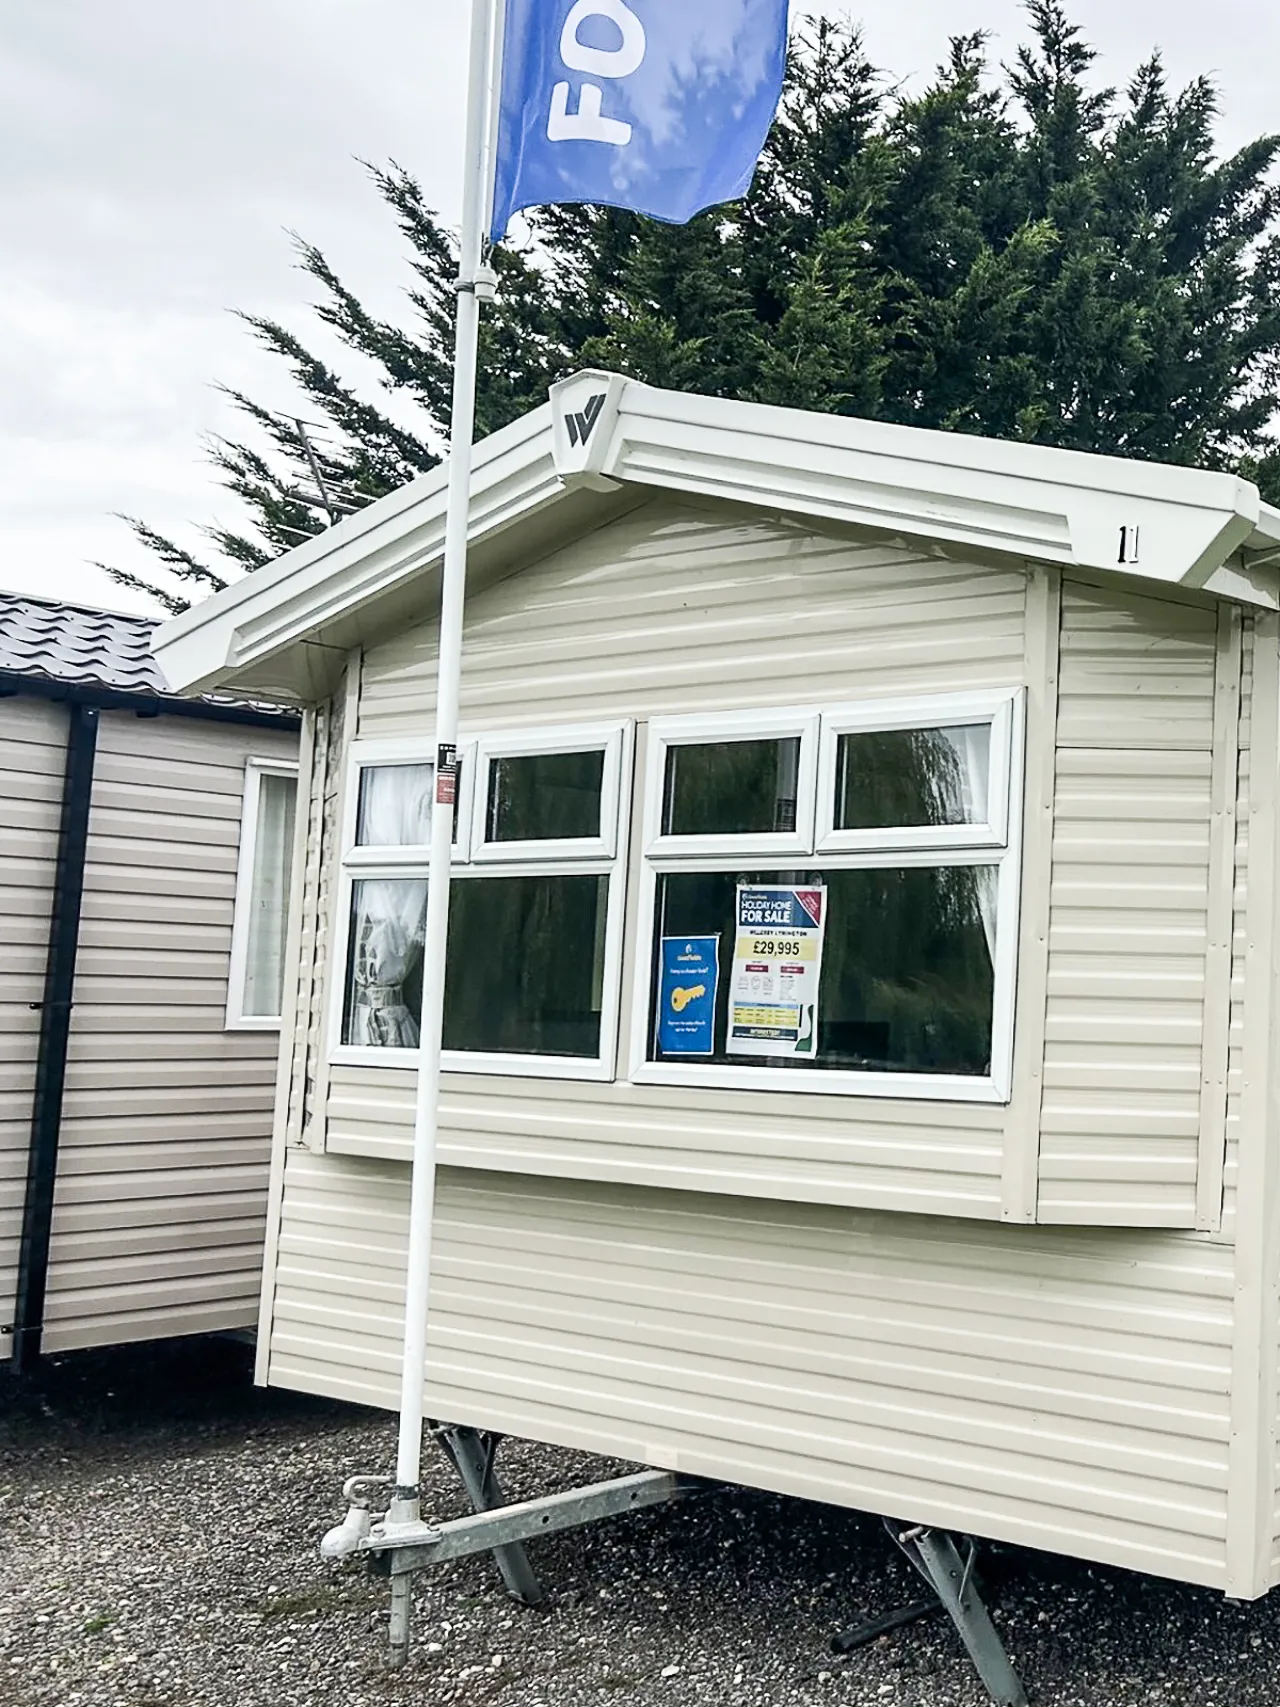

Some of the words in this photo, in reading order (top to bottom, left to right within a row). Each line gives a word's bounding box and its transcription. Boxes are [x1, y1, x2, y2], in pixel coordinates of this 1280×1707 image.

[1117, 525, 1139, 564] 11
[741, 900, 771, 910] HOLIDAY
[771, 901, 792, 910] HOME
[741, 909, 763, 922] FOR
[764, 910, 791, 923] SALE
[753, 940, 800, 956] £29,995
